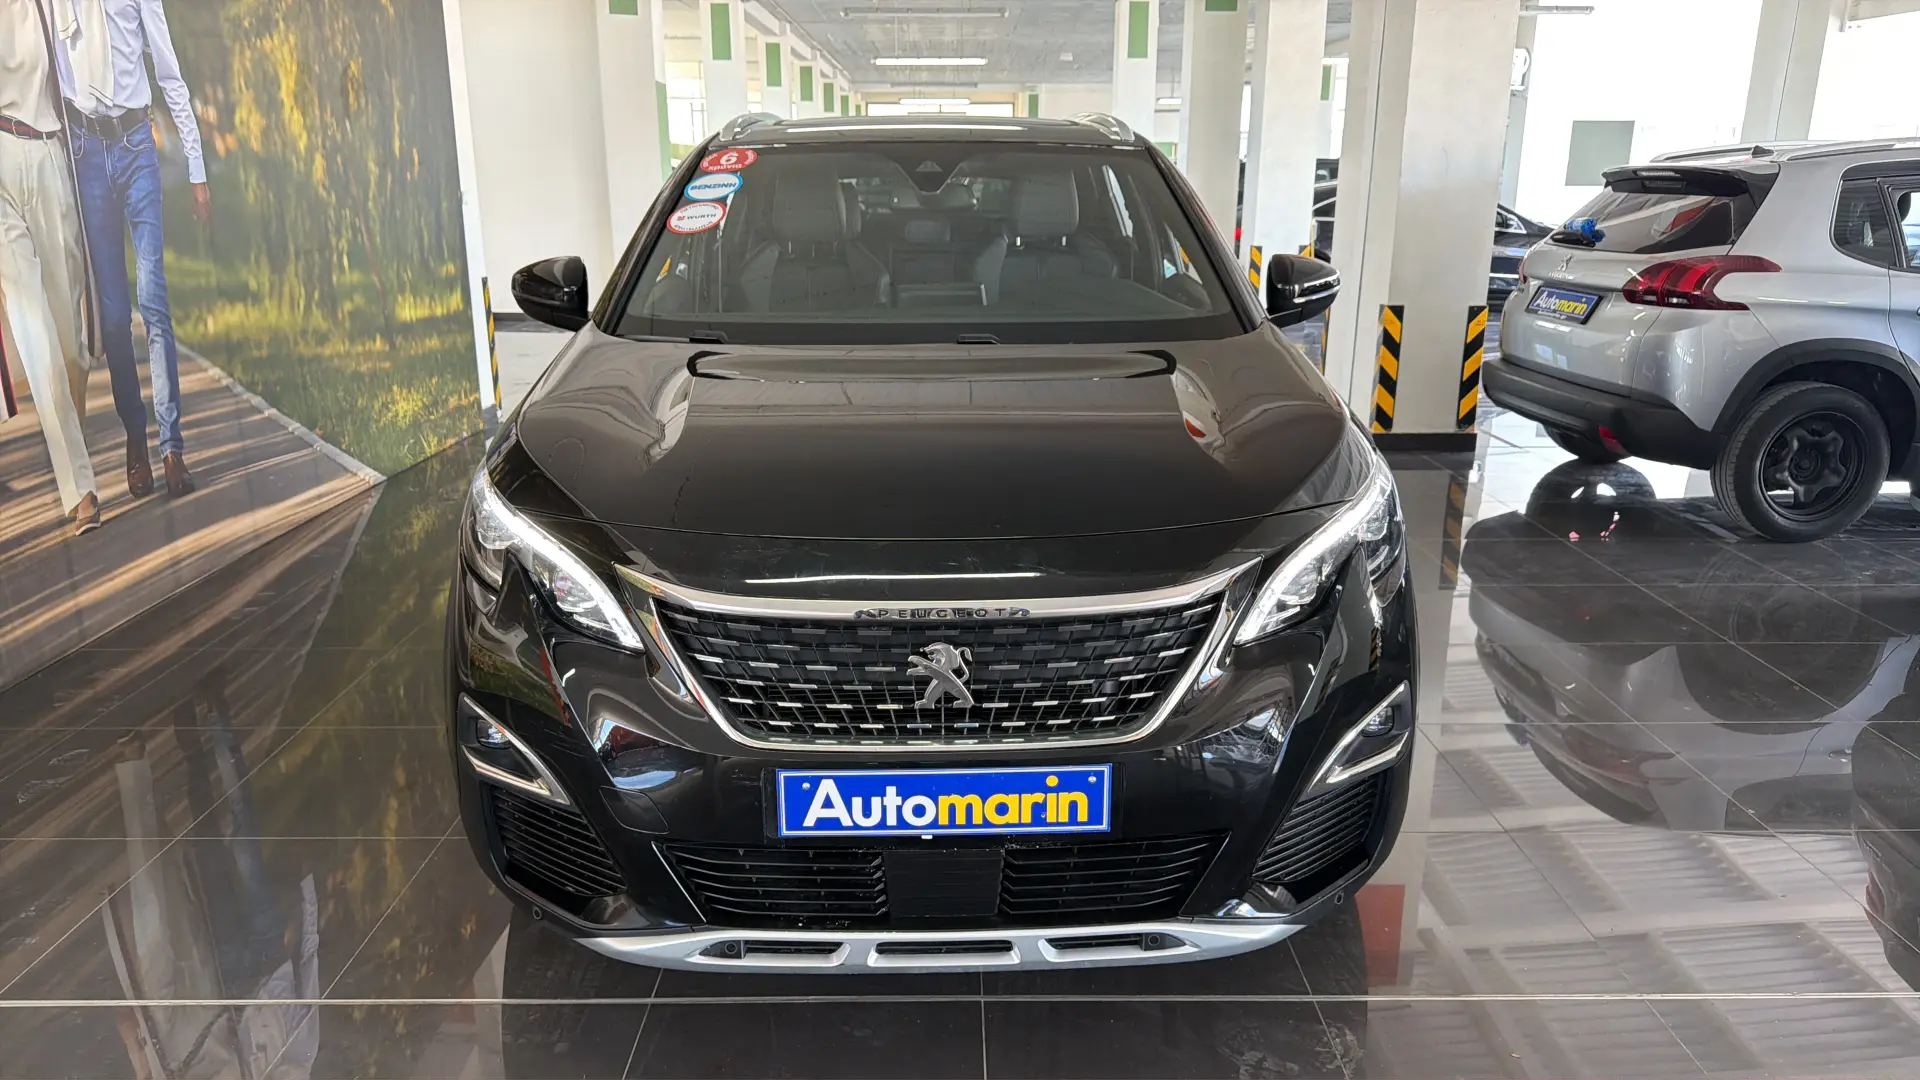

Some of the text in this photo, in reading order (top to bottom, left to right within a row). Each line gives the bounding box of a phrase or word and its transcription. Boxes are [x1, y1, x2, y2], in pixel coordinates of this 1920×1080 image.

[719, 151, 739, 166] 6
[1533, 290, 1588, 315] Automarin
[878, 608, 1006, 619] PEUGEOT
[802, 775, 1088, 828] Automarin
